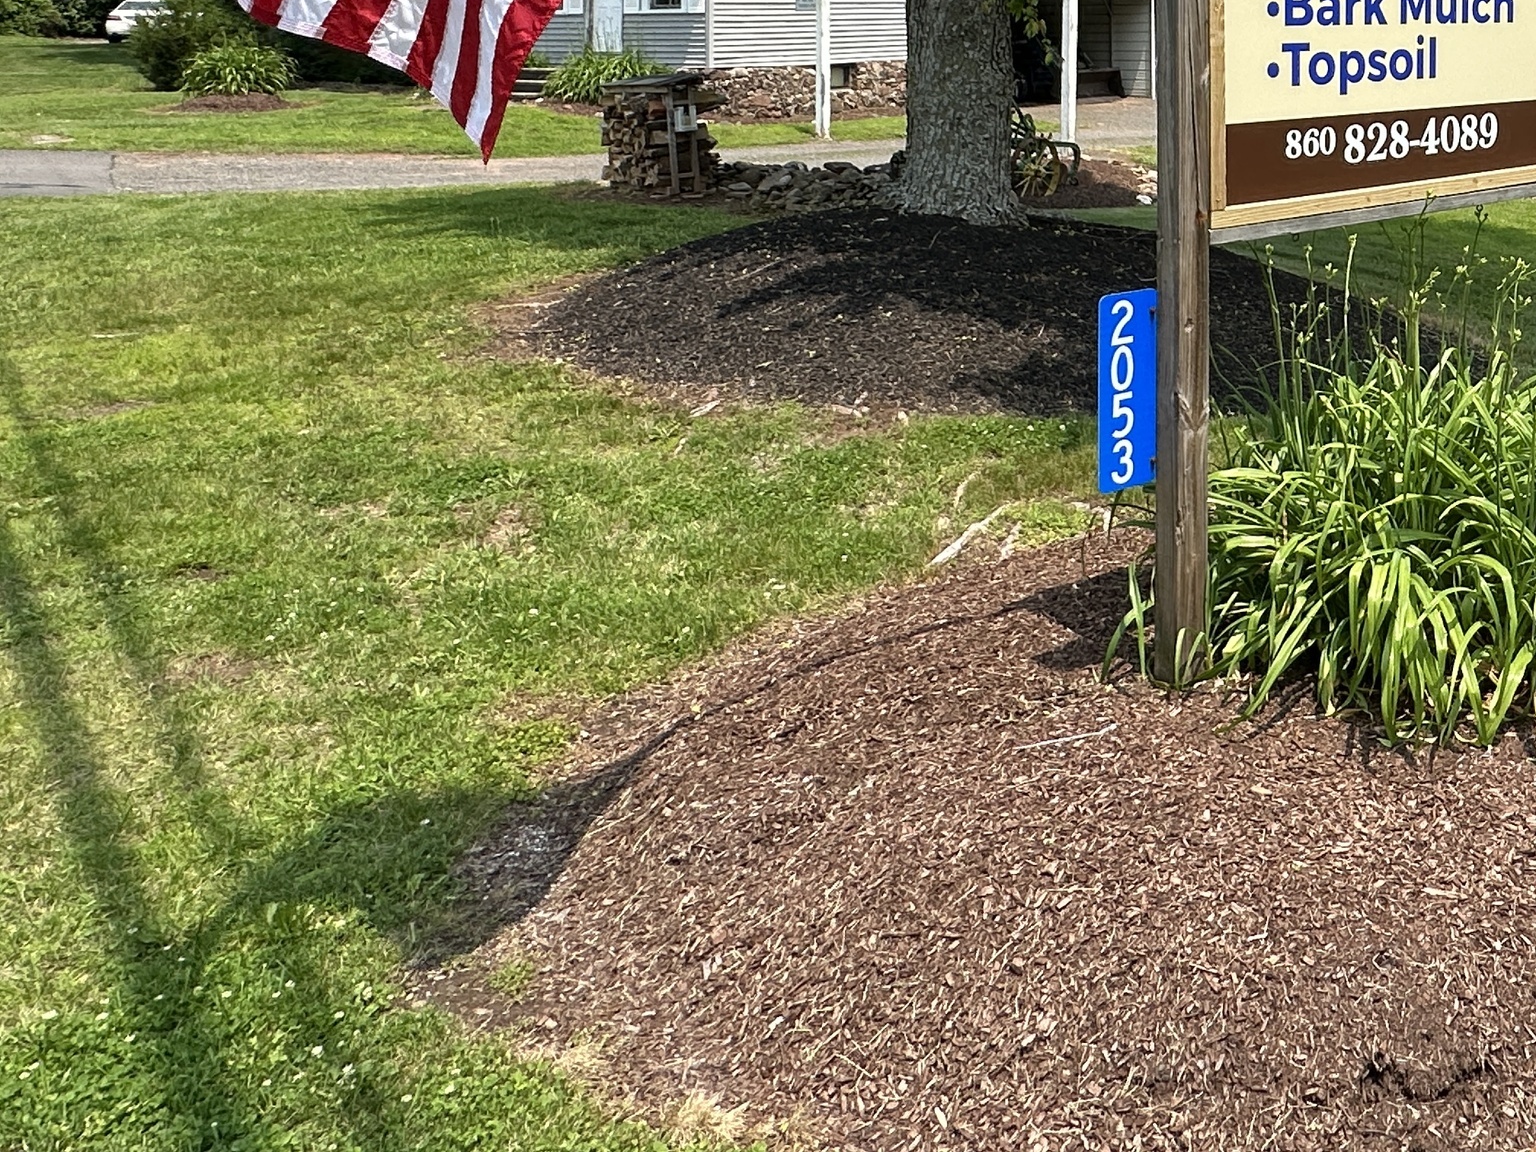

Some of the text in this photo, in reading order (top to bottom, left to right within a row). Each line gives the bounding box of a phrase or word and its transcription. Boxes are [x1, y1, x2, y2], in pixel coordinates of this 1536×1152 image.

[1285, 112, 1499, 165] 860 828-4089
[1110, 299, 1135, 485] 2053
